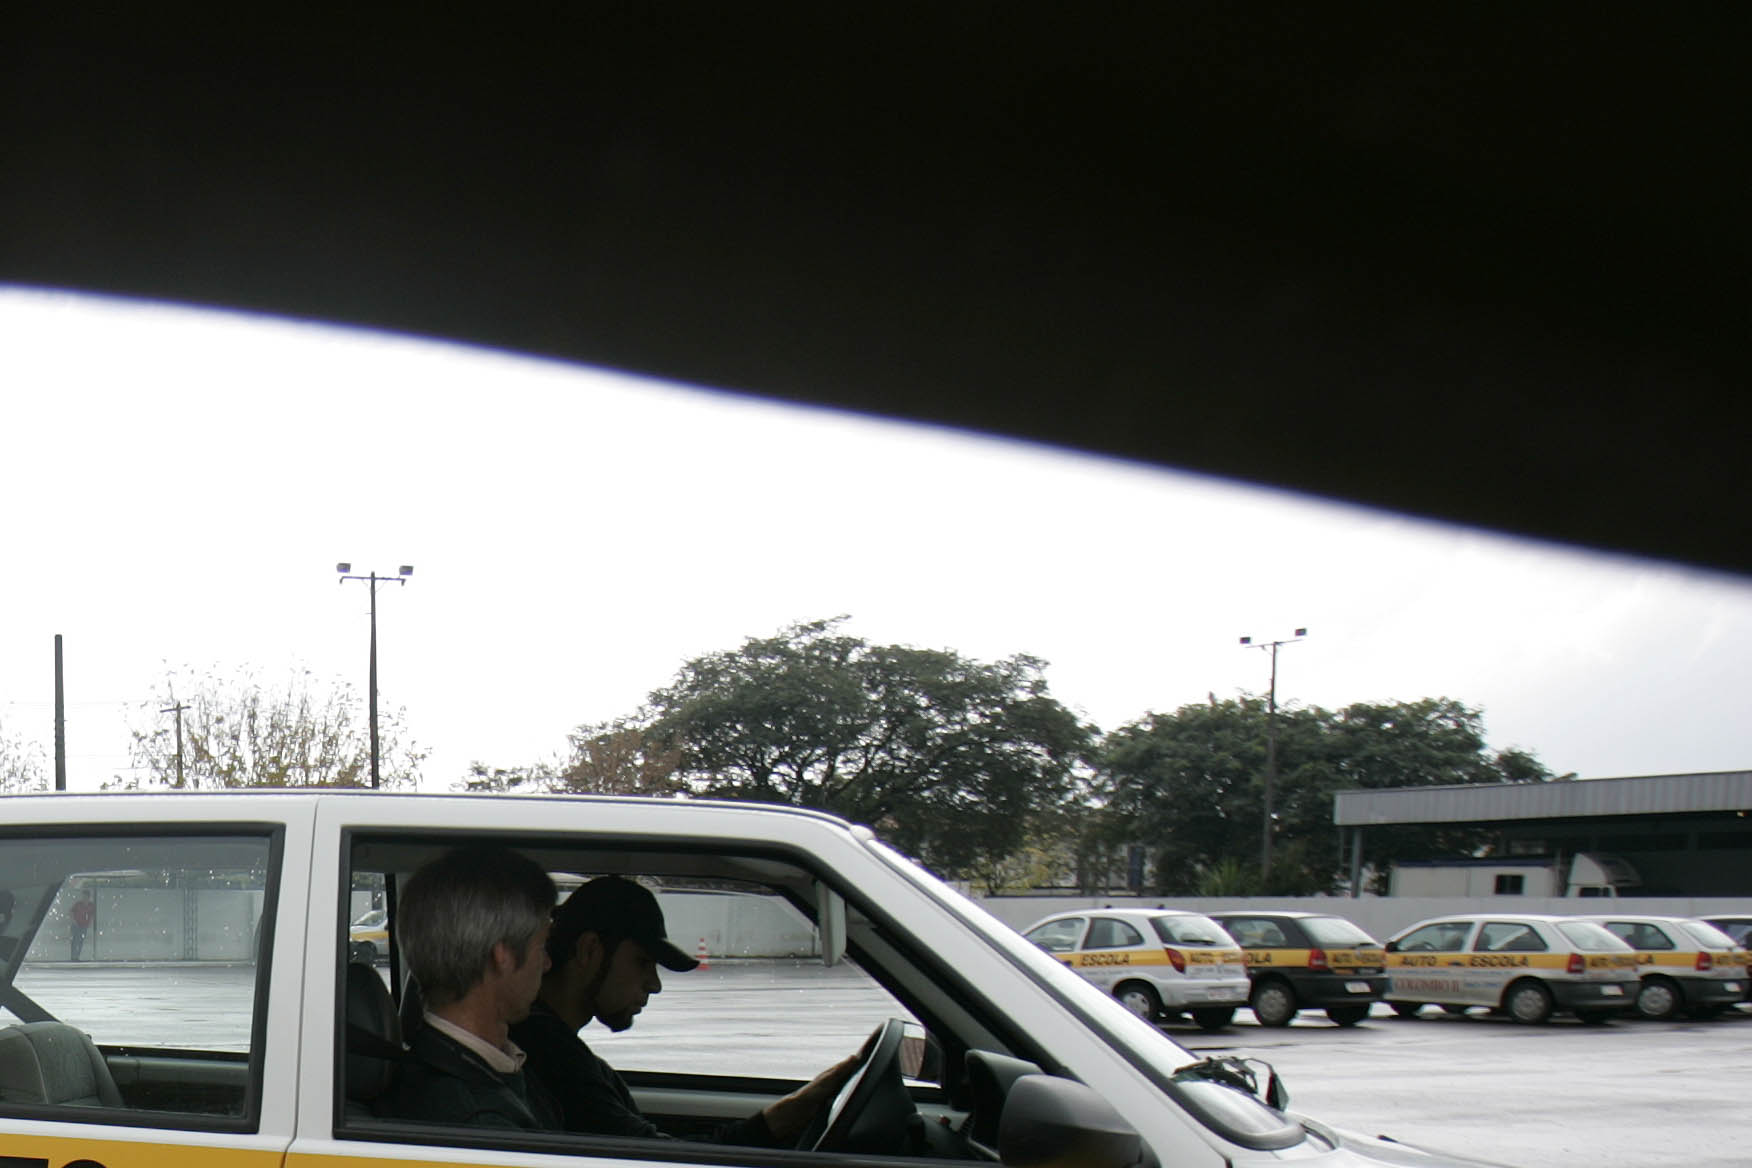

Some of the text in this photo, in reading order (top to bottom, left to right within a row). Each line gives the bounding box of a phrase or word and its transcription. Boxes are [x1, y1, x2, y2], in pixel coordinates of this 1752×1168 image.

[1080, 954, 1130, 967] ESCOLA
[1401, 956, 1529, 968] AUTO ESCOLA
